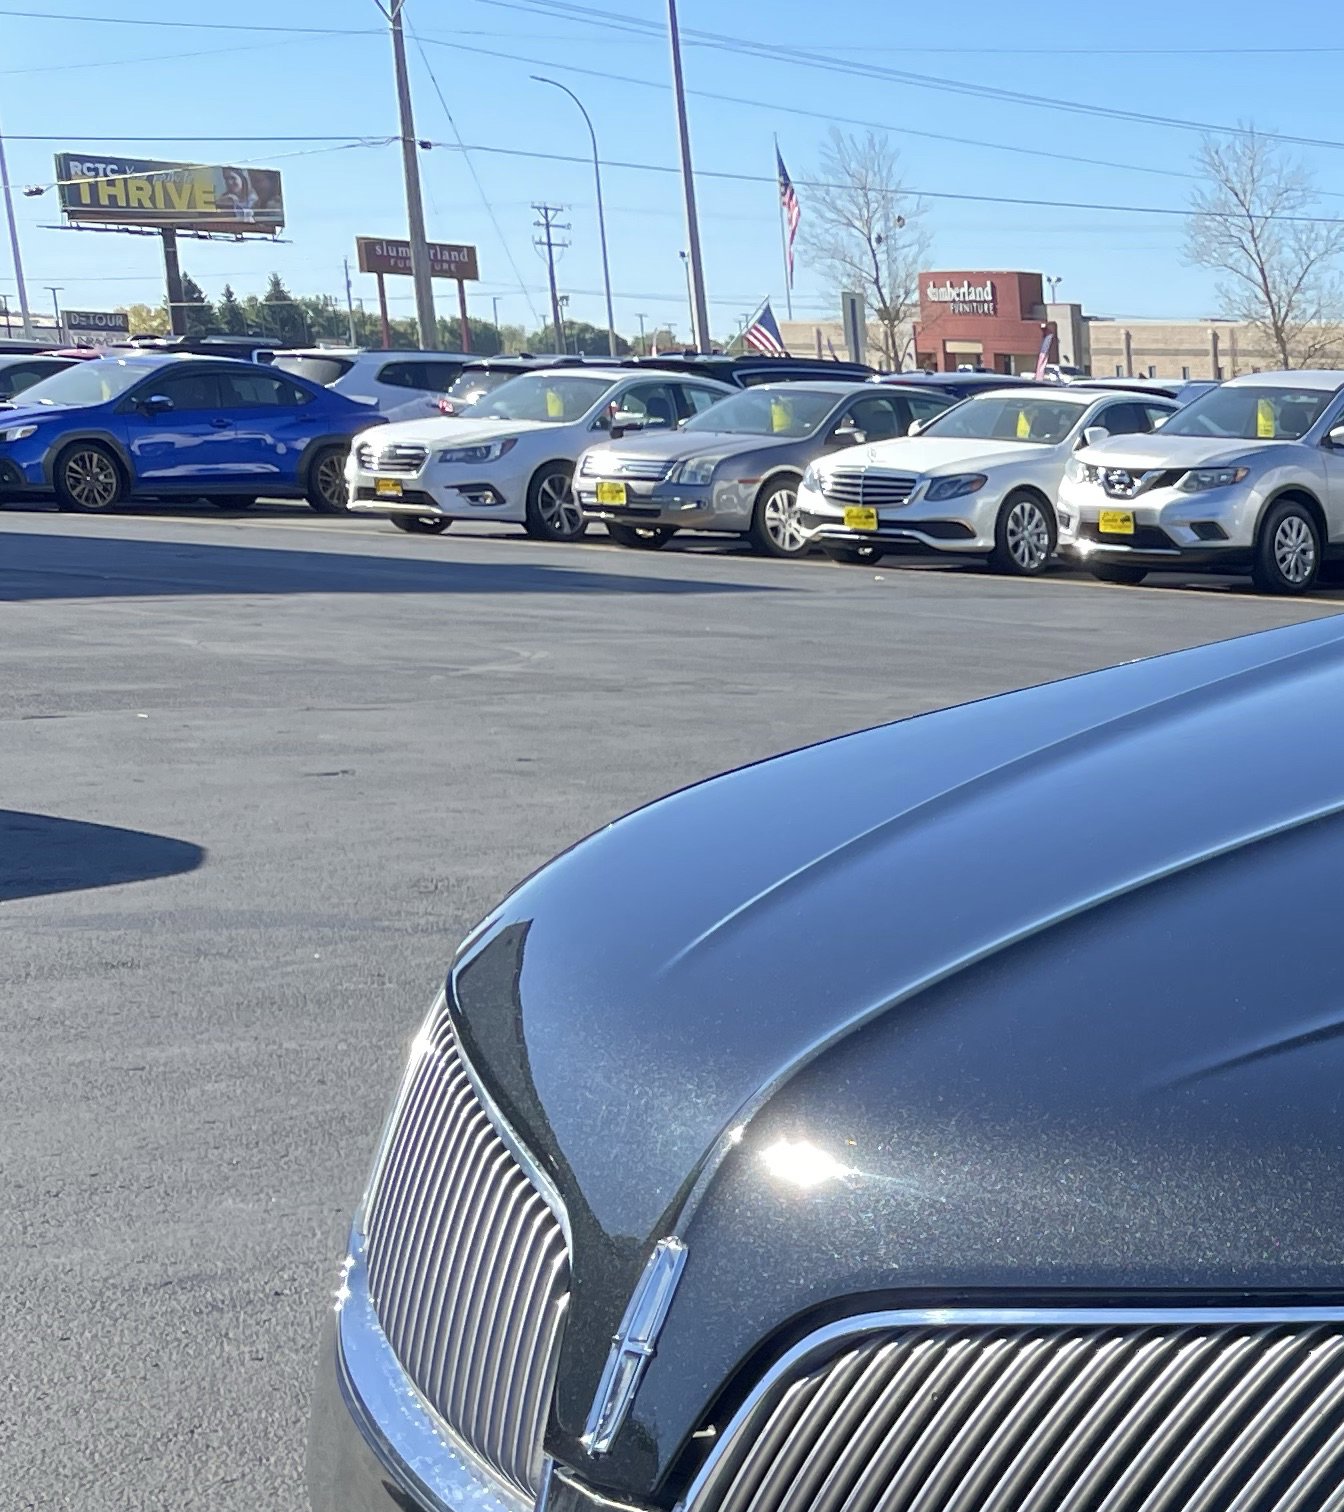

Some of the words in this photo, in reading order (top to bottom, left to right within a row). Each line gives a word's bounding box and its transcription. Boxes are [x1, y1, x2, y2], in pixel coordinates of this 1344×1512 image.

[69, 161, 119, 178] RCTC
[72, 175, 217, 212] THRIVE
[375, 241, 468, 262] slumrland
[390, 258, 457, 272] FURURE
[950, 302, 994, 314] FURNITURE
[71, 313, 124, 327] DETOUR
